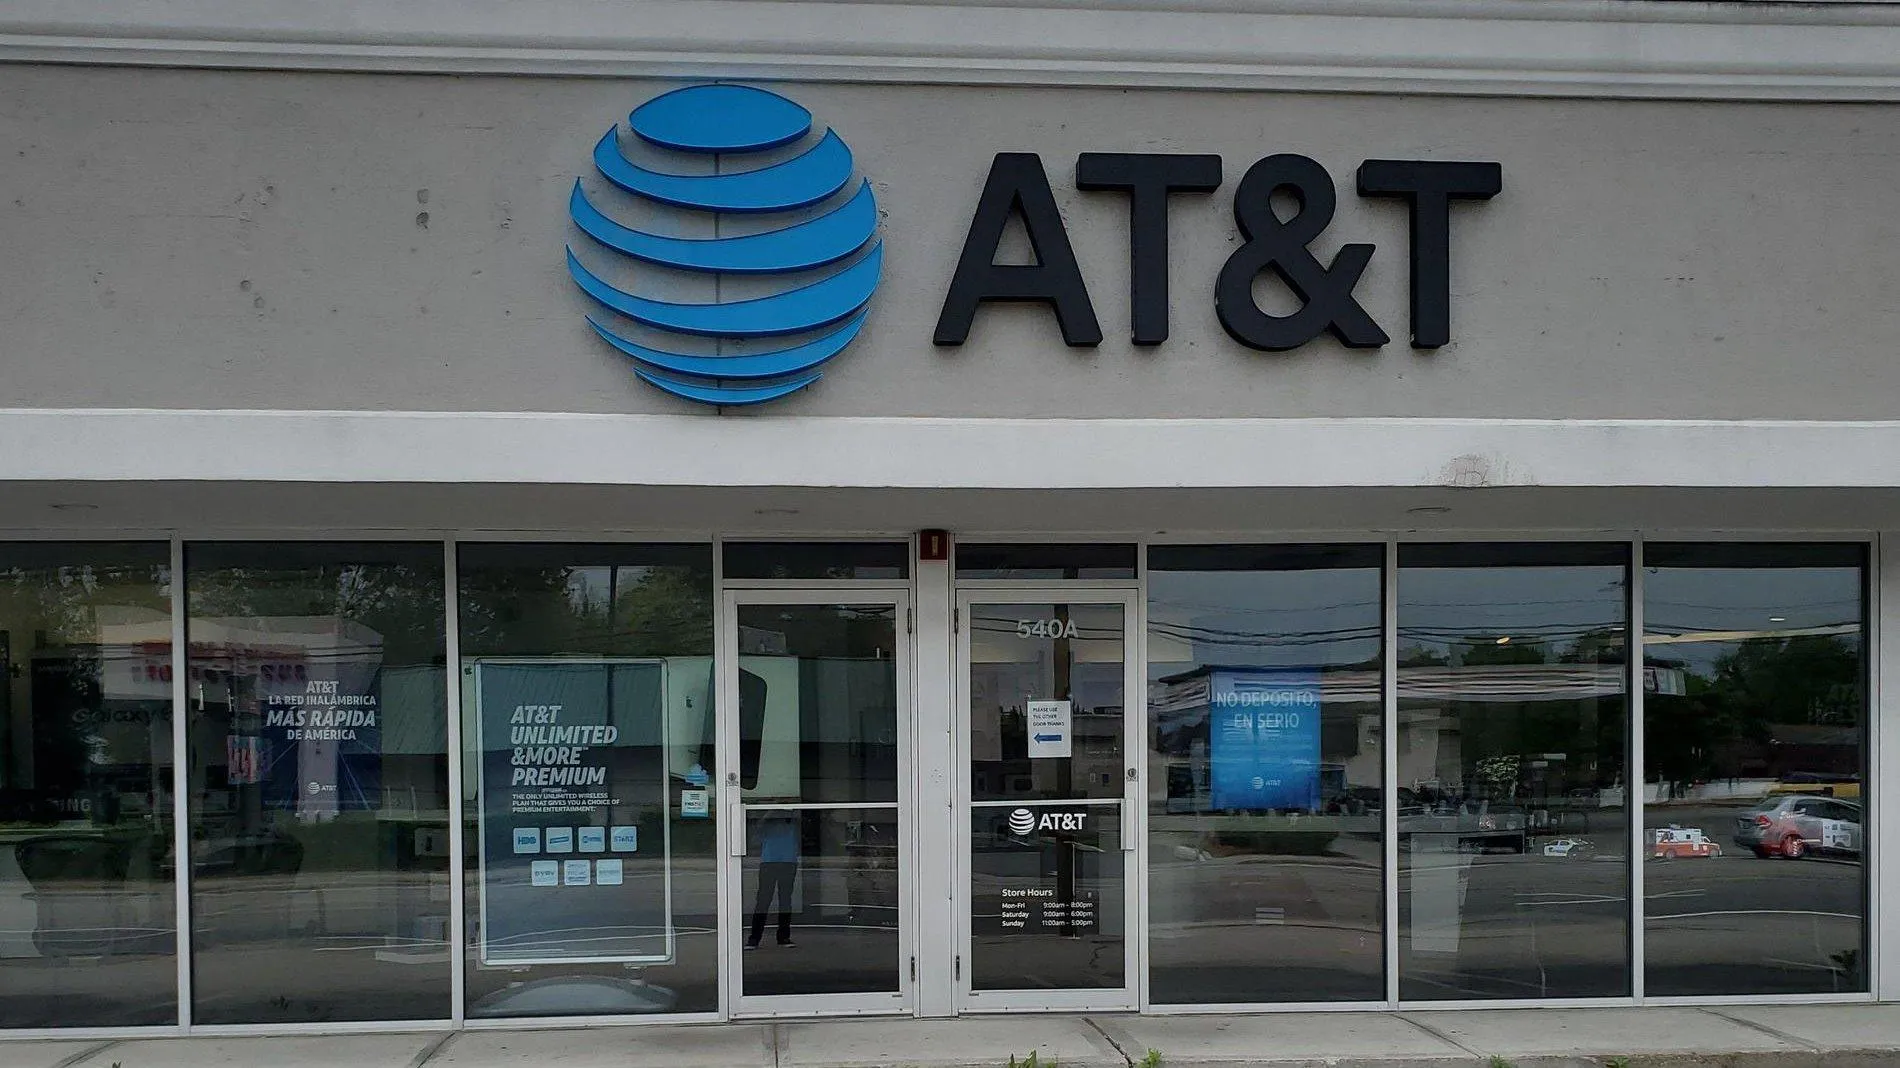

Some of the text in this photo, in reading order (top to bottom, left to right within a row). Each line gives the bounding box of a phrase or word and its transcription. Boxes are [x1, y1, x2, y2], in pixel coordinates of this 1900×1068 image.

[932, 152, 1502, 352] AT&T
[1016, 619, 1079, 639] 540A
[306, 680, 339, 694] AT&T
[268, 693, 377, 706] LA RED INALÁMBRICA
[1216, 691, 1239, 707] NO
[265, 706, 376, 727] MÁS RÁPIDA
[510, 705, 562, 724] AT&T
[1234, 713, 1300, 729] EN SERIO
[287, 727, 357, 741] DE AMÉRICA
[510, 725, 618, 744] UNLIMITED
[512, 766, 607, 786] PREMIUM
[1038, 813, 1087, 831] AT&T
[1001, 888, 1053, 897] Store Hours
[1042, 901, 1065, 909] 9:00am
[1001, 911, 1030, 920] Saturday
[1070, 910, 1094, 918] 6:00pm
[1001, 920, 1025, 928] Sunday
[1070, 919, 1094, 927] 5:00pm
